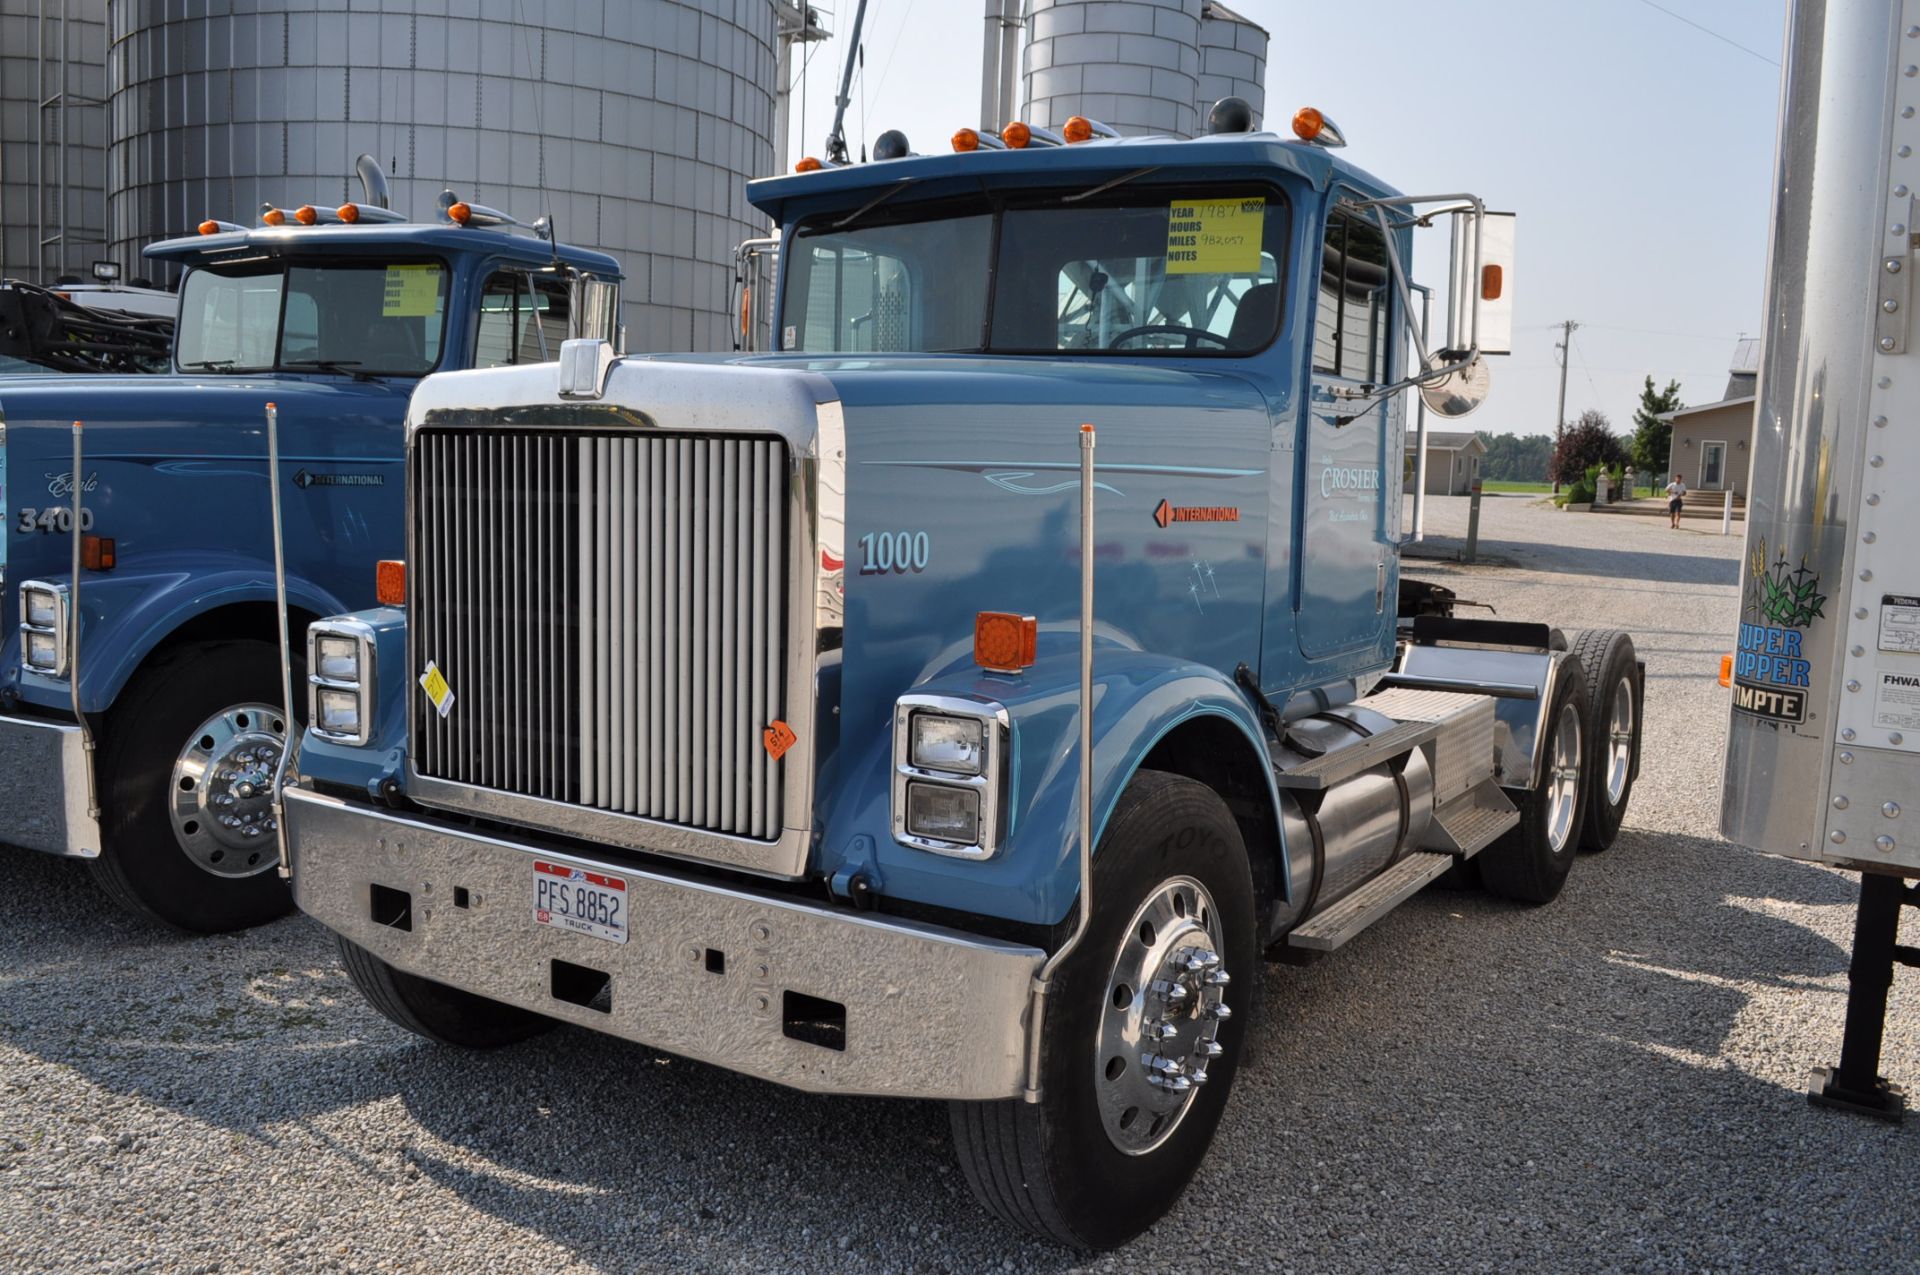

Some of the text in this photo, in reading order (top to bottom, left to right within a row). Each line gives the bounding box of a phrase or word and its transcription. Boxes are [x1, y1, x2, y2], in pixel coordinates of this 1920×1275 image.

[1172, 208, 1194, 218] YEAR
[1200, 204, 1237, 219] 1987
[1170, 221, 1202, 233] HOURS
[1169, 236, 1197, 247] MILES
[1167, 251, 1198, 262] NOTES
[44, 472, 97, 501] Eale
[314, 474, 384, 486] INTERNATIONAL
[1321, 467, 1380, 499] CROSIER
[17, 507, 94, 534] 3400
[1175, 507, 1241, 522] INTERNATIONAL
[858, 531, 930, 575] 1000
[1736, 650, 1811, 687] OPPER
[538, 879, 619, 928] PFS 8852
[565, 919, 593, 931] TRUCK
